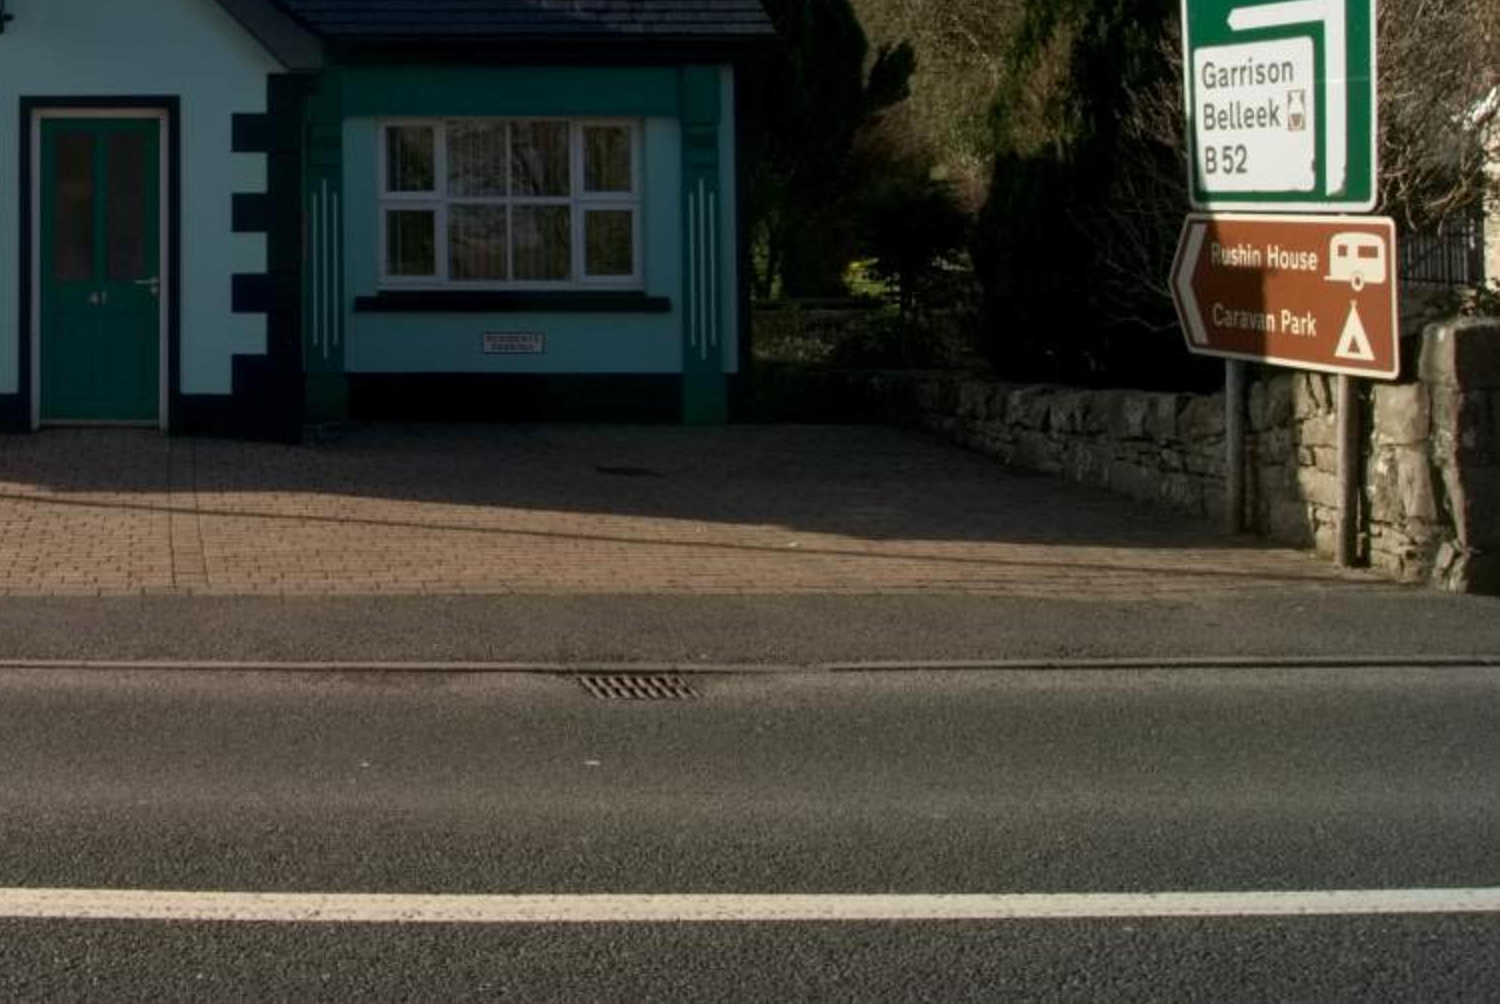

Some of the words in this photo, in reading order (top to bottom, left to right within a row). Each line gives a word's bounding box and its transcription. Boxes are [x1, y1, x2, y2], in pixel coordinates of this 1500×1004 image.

[1202, 57, 1294, 90] Garrison
[1203, 98, 1281, 131] Belleek
[1211, 242, 1261, 268] Rushin
[1267, 244, 1318, 271] House
[1212, 302, 1276, 332] Caravan
[1281, 309, 1317, 337] Park
